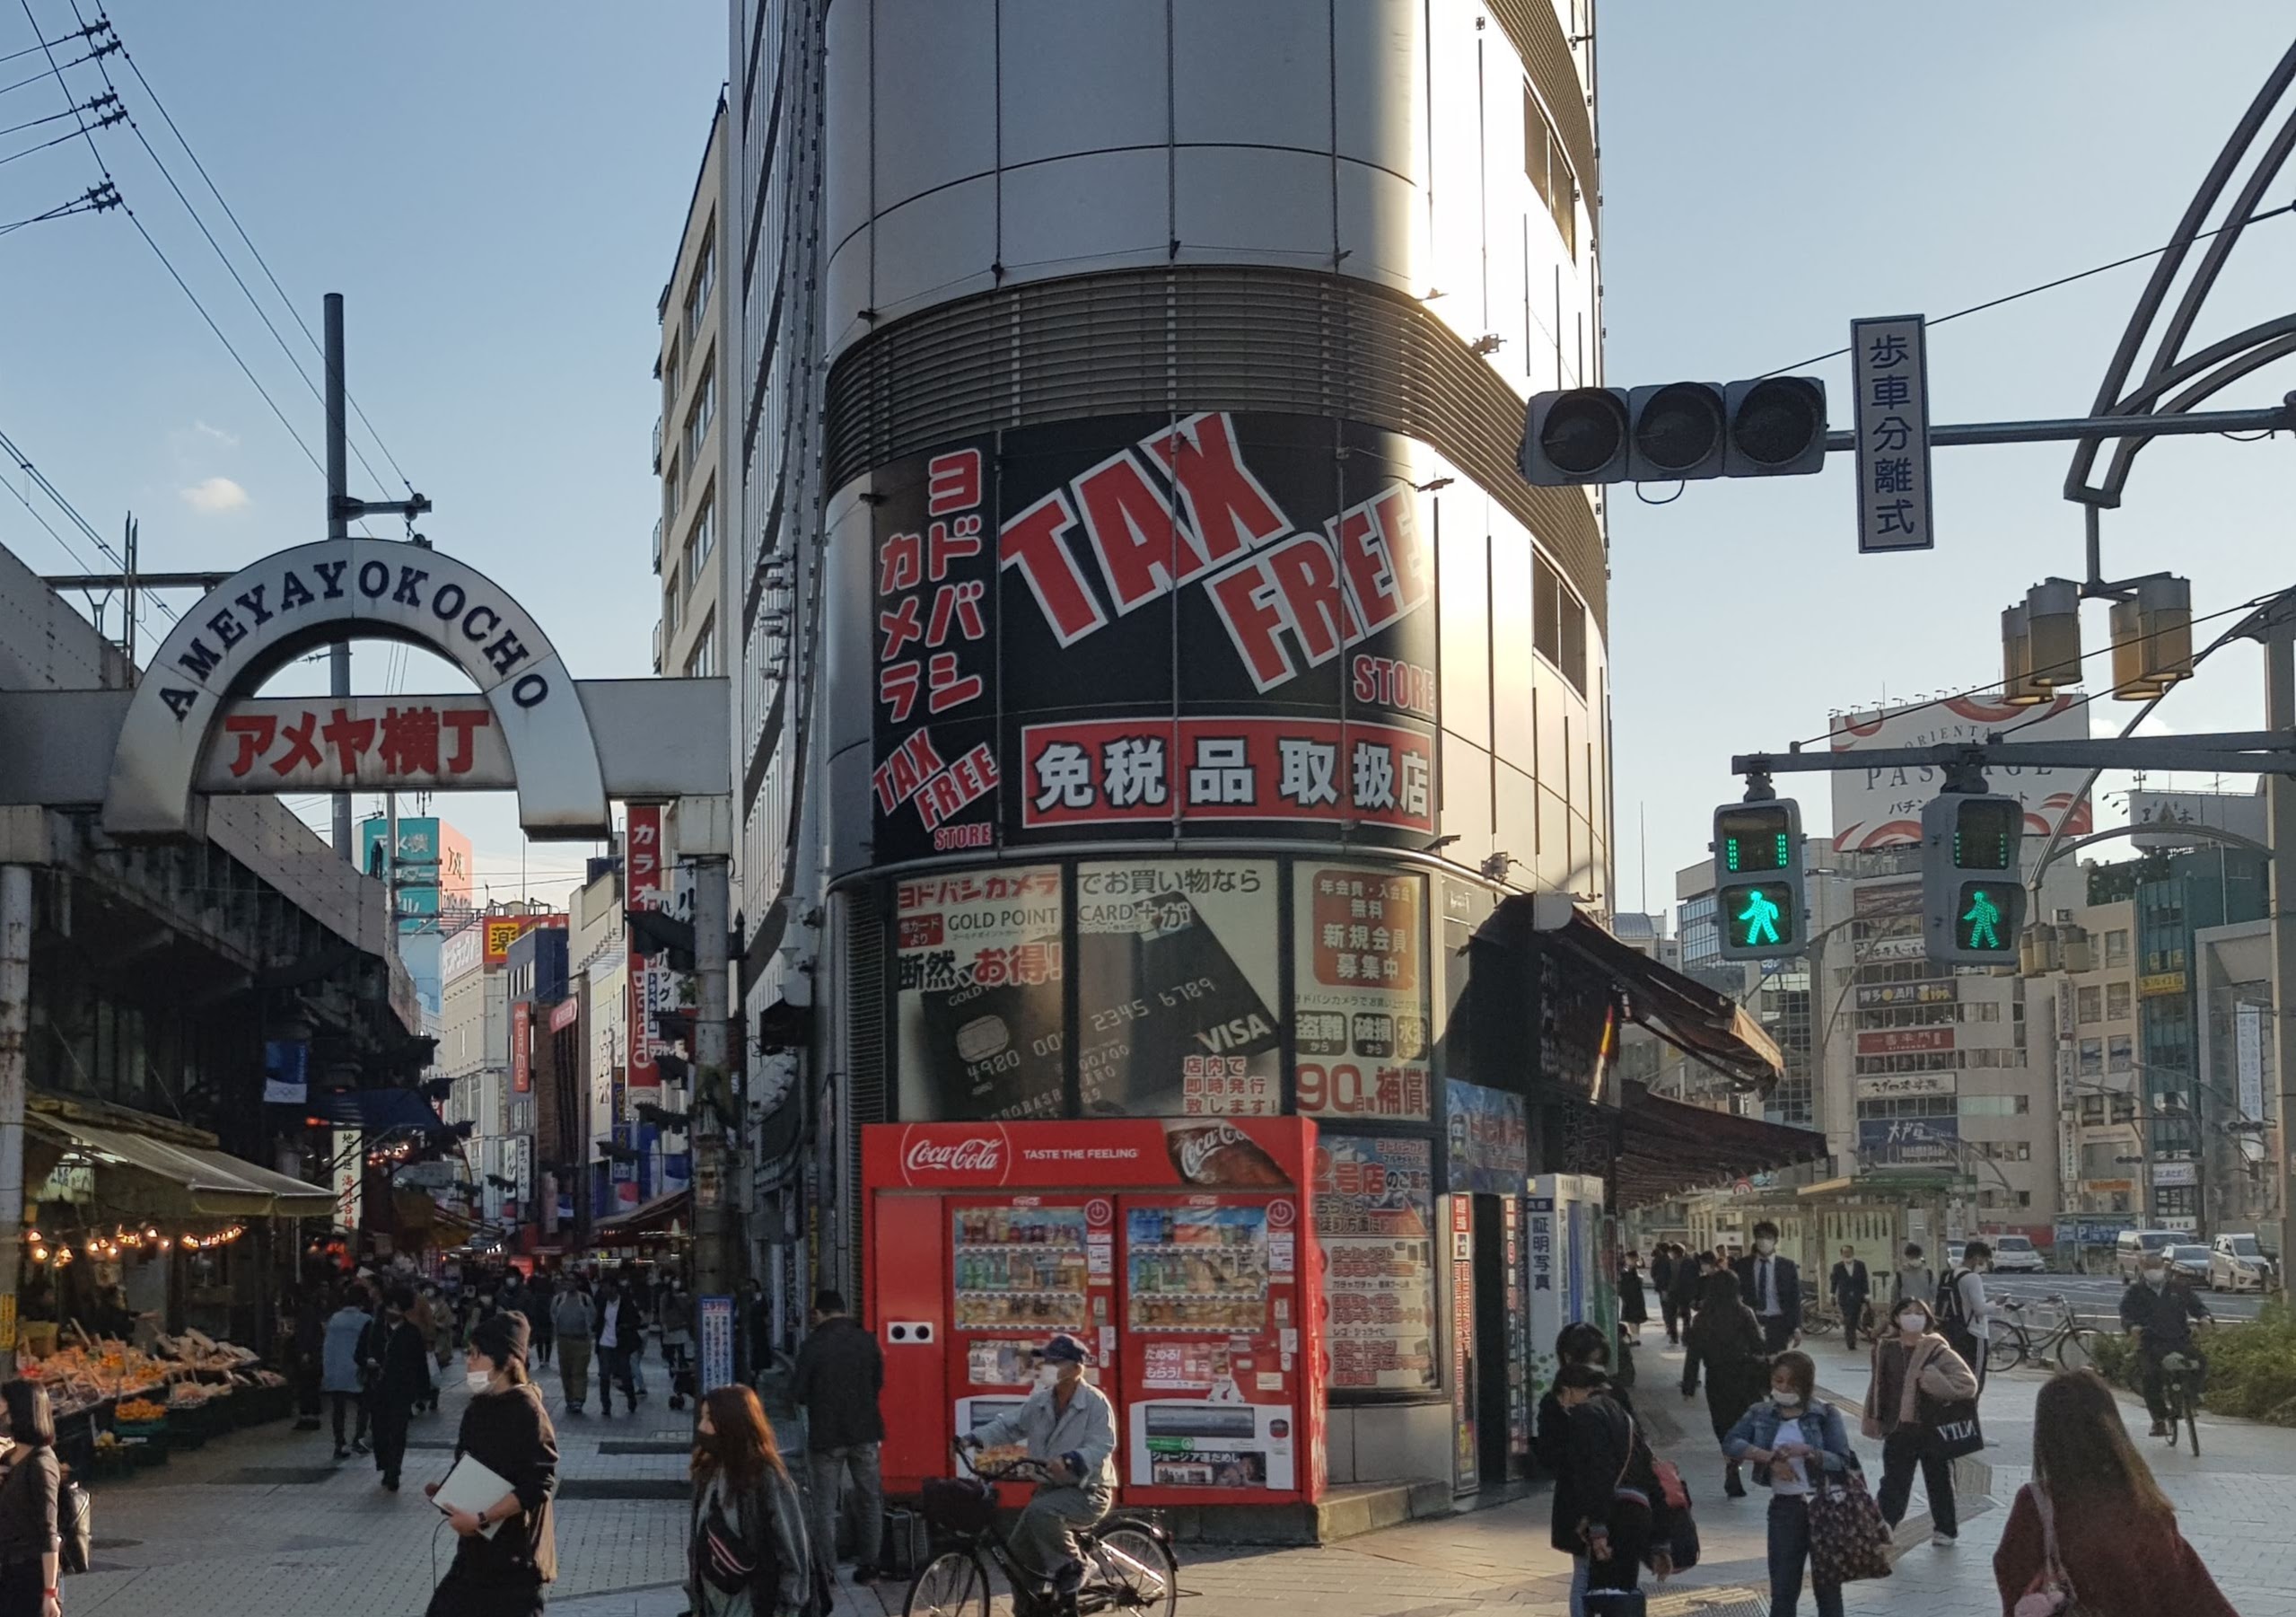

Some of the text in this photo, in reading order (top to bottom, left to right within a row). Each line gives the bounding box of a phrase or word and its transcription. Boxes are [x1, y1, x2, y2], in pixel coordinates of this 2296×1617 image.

[1869, 334, 1915, 536] 歩車分離式
[999, 411, 1296, 649] TAX
[927, 448, 986, 716] ヨドバシ
[1201, 482, 1433, 695] FREE
[158, 558, 549, 723] AMEYAYOKOCHO
[879, 532, 922, 724] カメラ
[1352, 654, 1436, 717] STORE
[224, 708, 490, 778] アメヤ横丁
[1905, 725, 1993, 750] ORIENTA
[872, 727, 948, 817] TAX
[912, 741, 1000, 834] FREE
[1034, 735, 1431, 819] 免税品取扱店
[933, 822, 993, 851] STORE
[898, 868, 1261, 910] ヨドバシカメラ でお買い物なら
[1351, 899, 1383, 919] 無料
[948, 912, 995, 931] GOLD
[1001, 908, 1058, 927] POINT
[1078, 904, 1134, 922] CARD
[1323, 923, 1407, 954] 新規会員
[1336, 953, 1399, 980] 募集中
[1091, 998, 1150, 1032] 2345
[1158, 977, 1216, 1007] 6789
[1295, 1014, 1344, 1041] 盗難
[1194, 1013, 1272, 1054] VISA
[1185, 1057, 1246, 1075] 店内で
[1185, 1077, 1266, 1095] 即時発行
[907, 1137, 1004, 1172] Coca-Cola
[1023, 1148, 1138, 1160] TASTE THE FEELING
[1532, 1217, 1550, 1291] 証明写真
